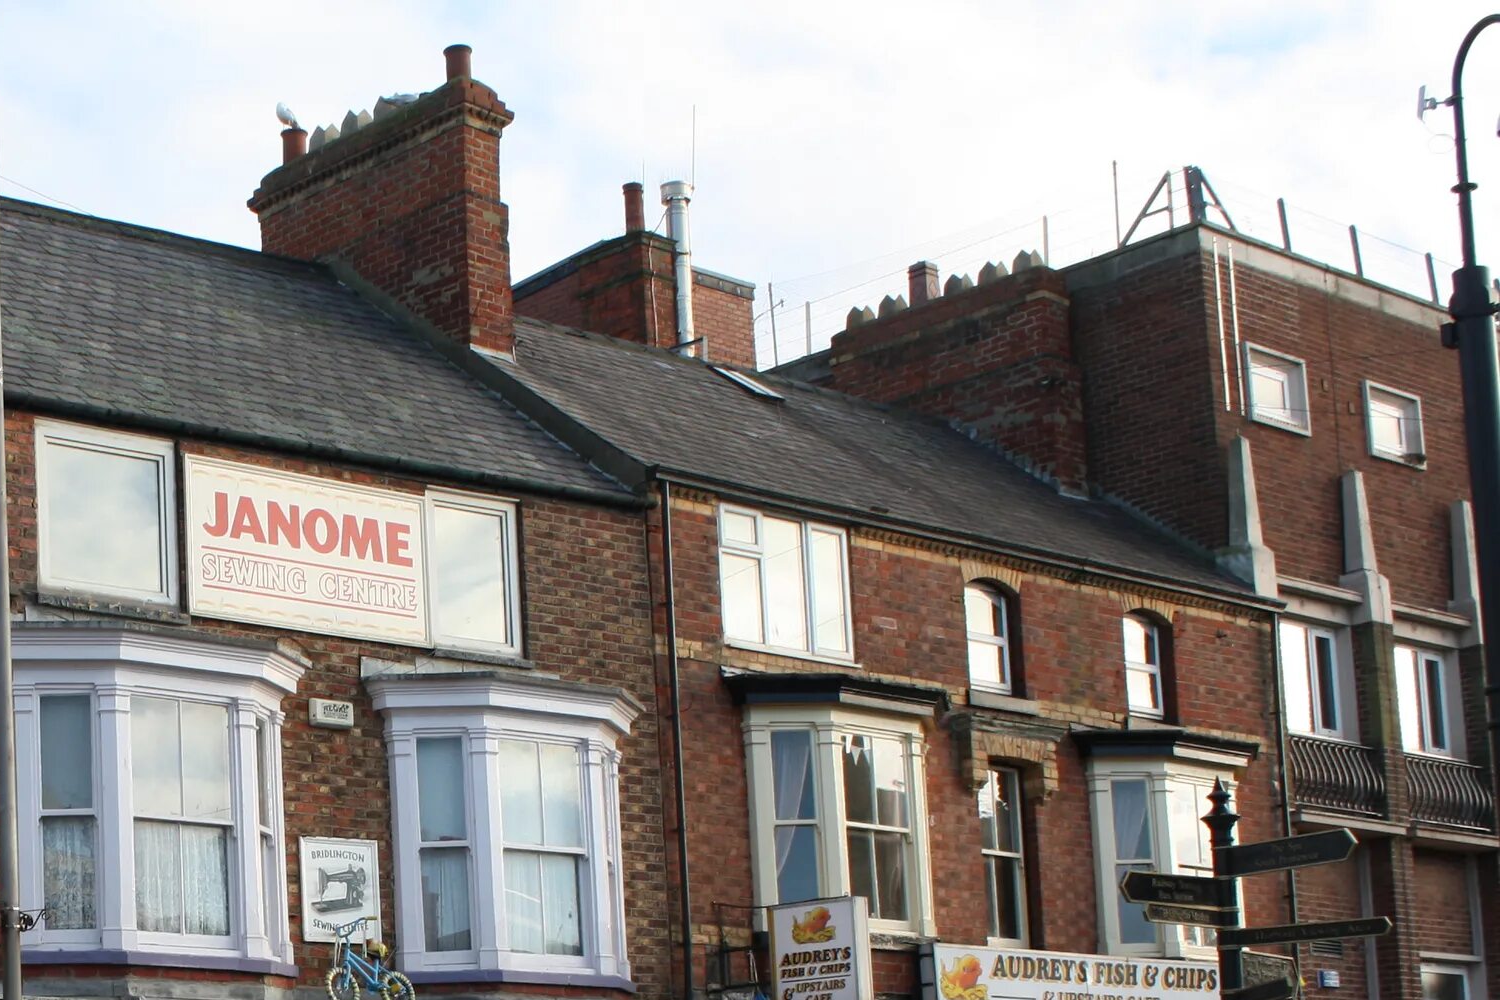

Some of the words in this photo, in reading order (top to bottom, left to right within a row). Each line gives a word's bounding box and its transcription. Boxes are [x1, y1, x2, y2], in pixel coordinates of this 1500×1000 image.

[202, 491, 413, 567] JANOME
[201, 552, 307, 594] SEWING
[318, 572, 418, 611] CENTRE
[311, 849, 365, 862] BRIDLINGTON
[313, 918, 341, 932] SEWIN
[781, 967, 805, 979] FISH
[807, 966, 817, 976] &
[820, 962, 852, 975] CHIPS
[1093, 962, 1138, 987] FISH
[1142, 965, 1159, 988] &
[1162, 966, 1217, 991] CHIPS
[796, 978, 847, 993] UPSTAIRS
